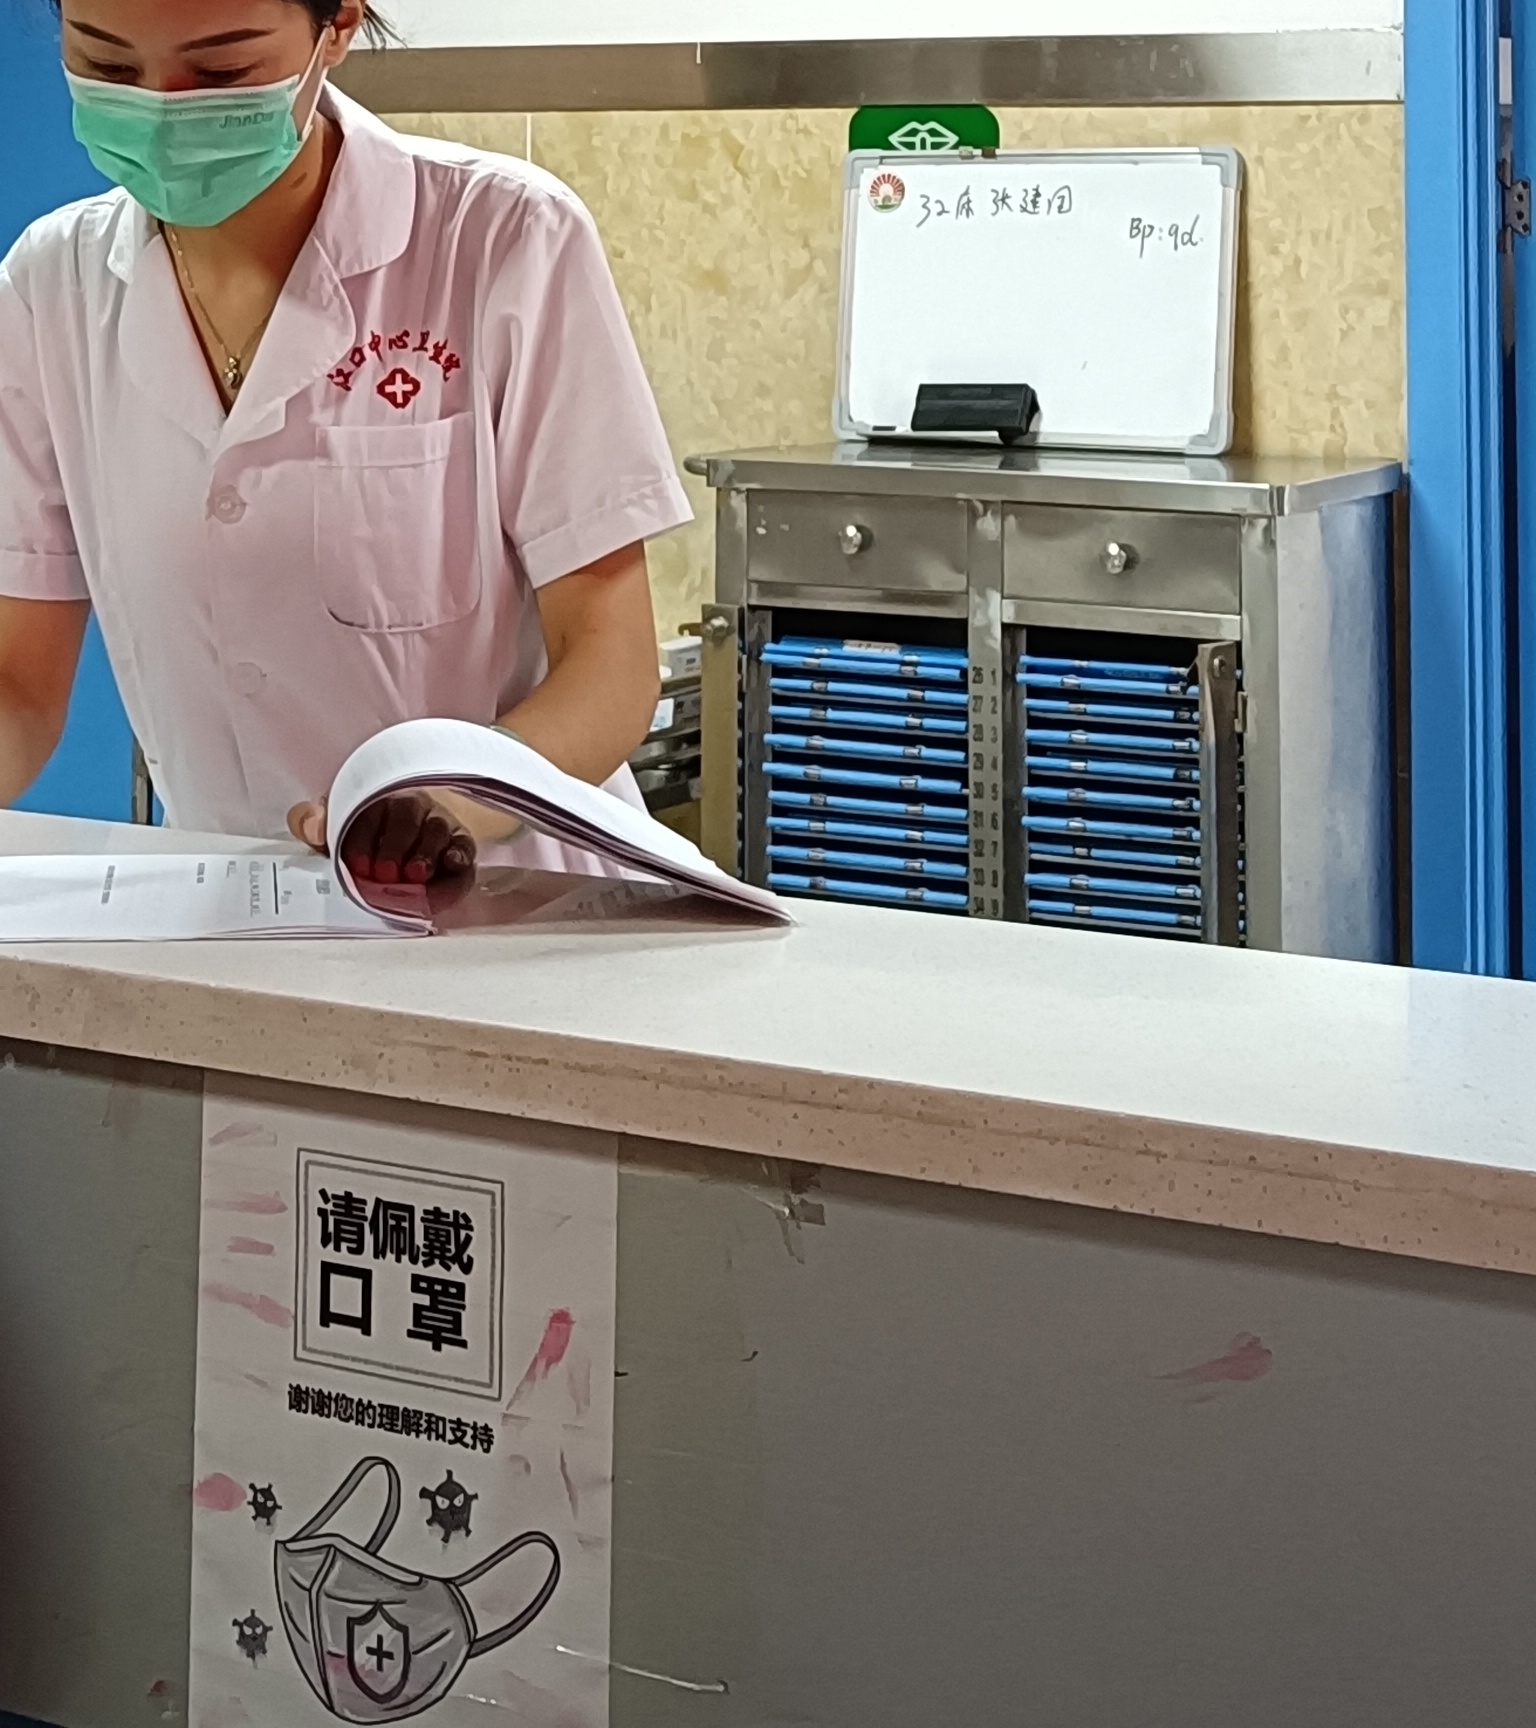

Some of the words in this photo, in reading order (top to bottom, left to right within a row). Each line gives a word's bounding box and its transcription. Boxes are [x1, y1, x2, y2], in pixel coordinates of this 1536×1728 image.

[316, 1188, 474, 1275] 请佩戴
[317, 1260, 469, 1352] 口罩
[287, 1383, 495, 1454] 谢谢您的理解和支持
